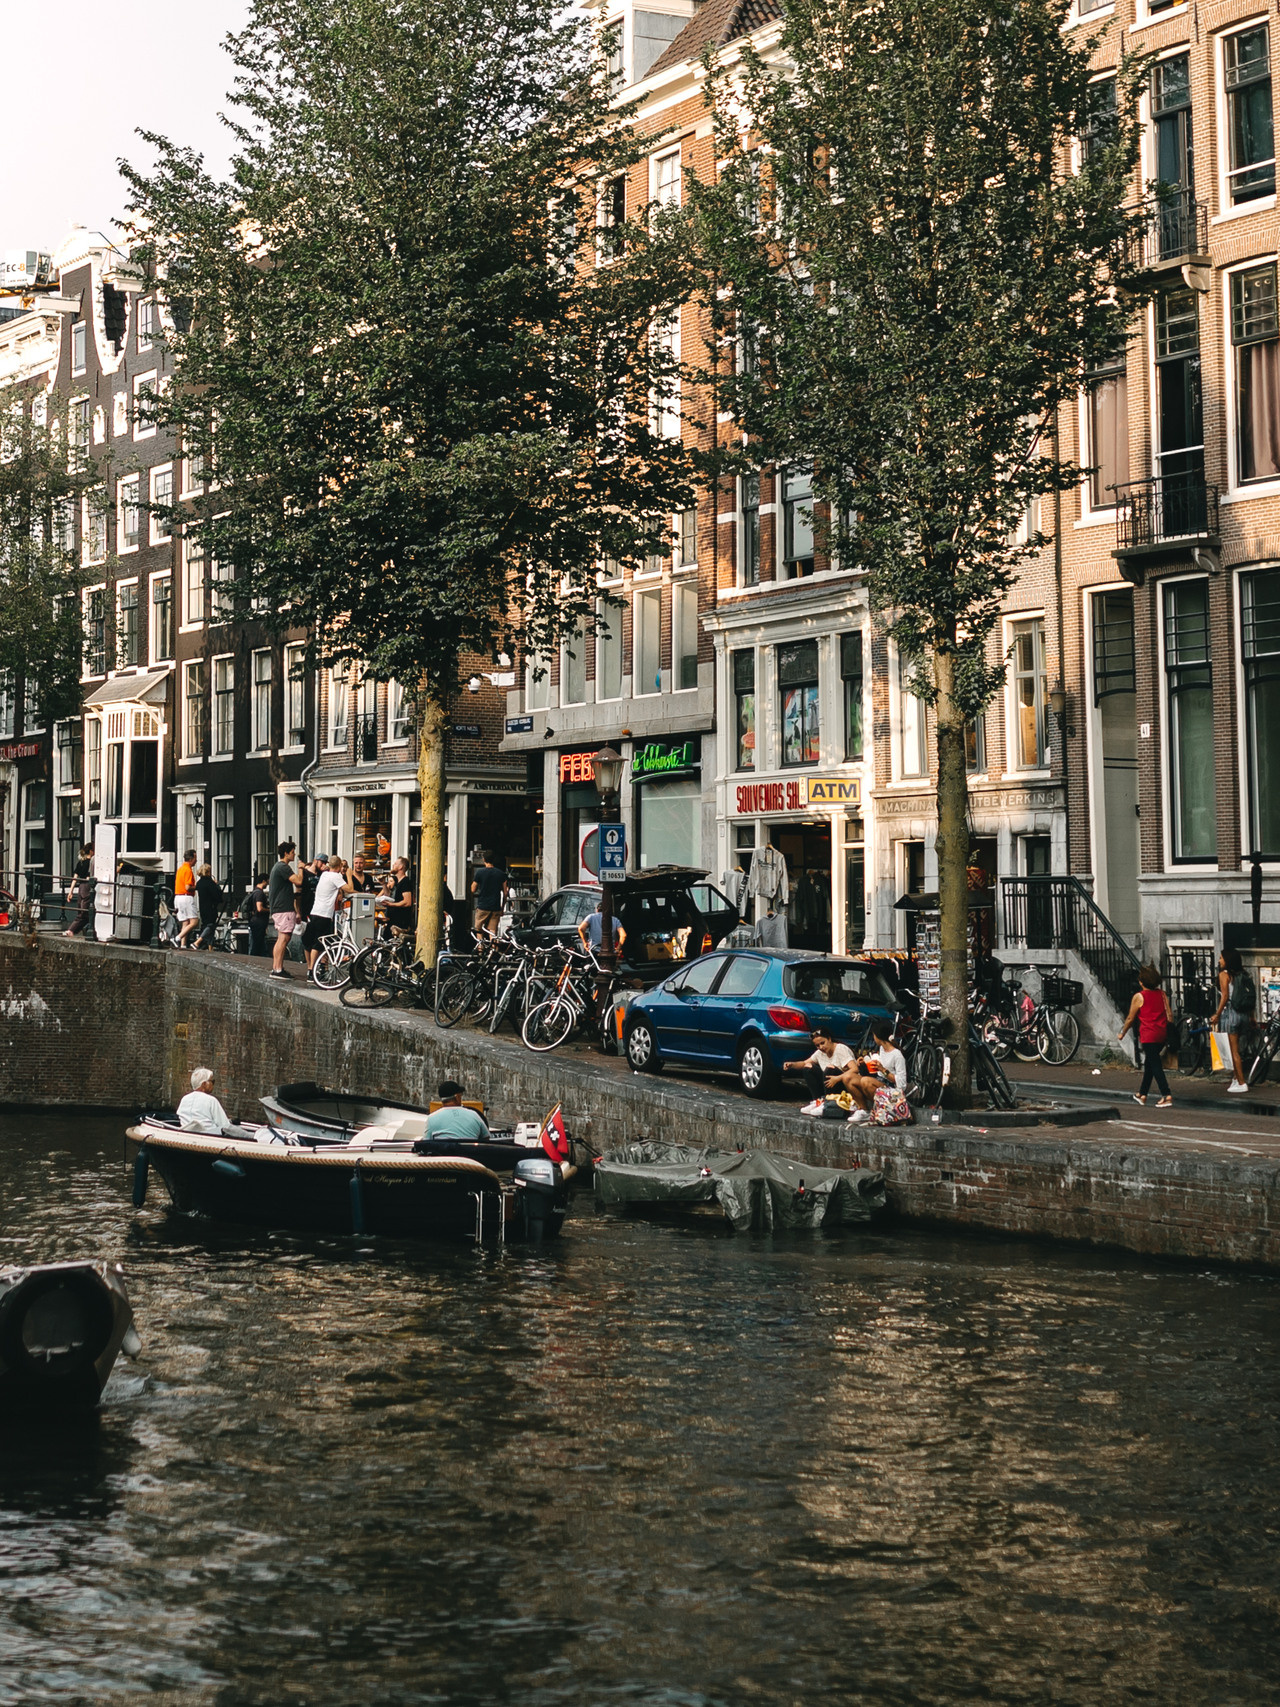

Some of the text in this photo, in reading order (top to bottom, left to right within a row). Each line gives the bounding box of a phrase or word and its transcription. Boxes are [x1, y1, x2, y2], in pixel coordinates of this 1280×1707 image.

[7, 745, 17, 759] the
[17, 743, 39, 757] Crown
[473, 783, 517, 791] AMSTERDAM
[811, 783, 857, 798] ATM
[736, 782, 784, 813] SOUVENIRS
[885, 792, 1054, 814] MACHINA UTBEWERKING
